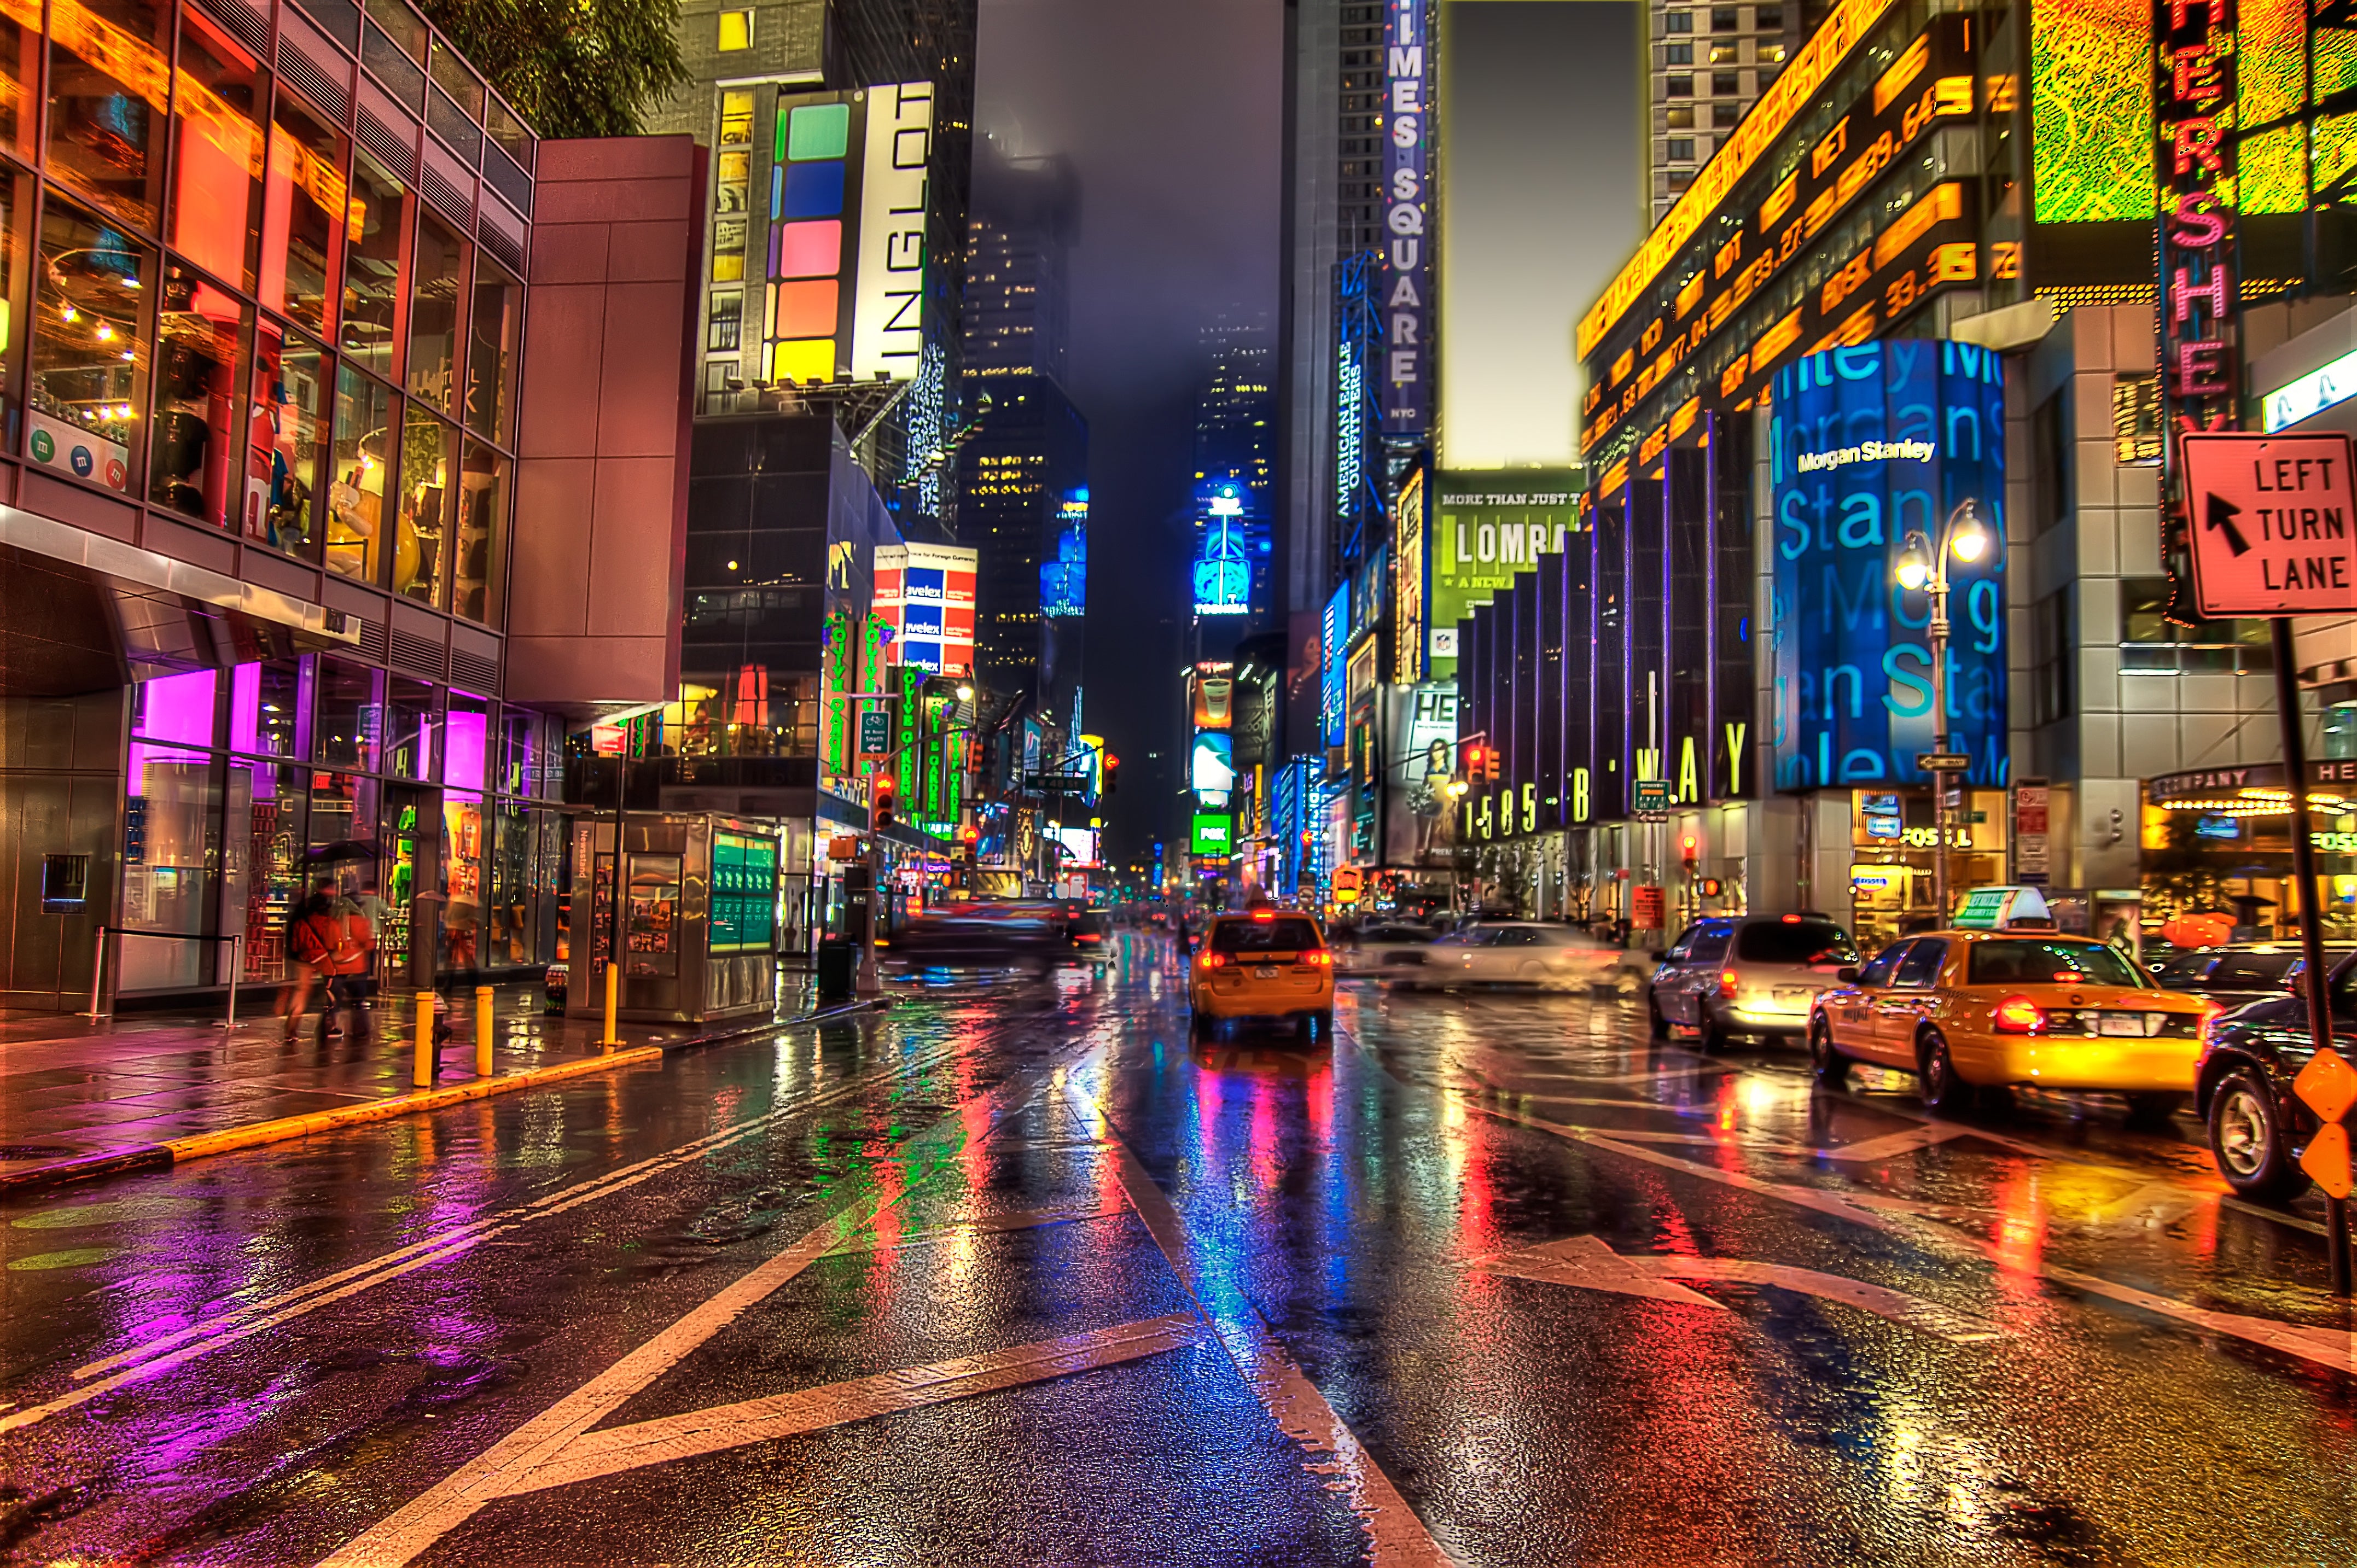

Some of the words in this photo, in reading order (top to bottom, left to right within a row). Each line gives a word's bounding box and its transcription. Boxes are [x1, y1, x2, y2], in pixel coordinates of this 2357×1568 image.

[1389, 0, 1422, 148] IMES
[880, 83, 932, 359] INGLOT
[2172, 0, 2226, 432] ERSHE
[1388, 167, 1423, 383] SQUARE
[1339, 341, 1351, 403] EAGLE
[1349, 364, 1361, 489] OUTFITTERS
[1390, 409, 1416, 419] NYC
[1337, 408, 1350, 518] AMERICAN
[1798, 445, 1860, 474] Morgan
[1861, 438, 1936, 465] Stanley
[2254, 458, 2334, 492] LEFT
[1442, 493, 1483, 505] MORE
[1486, 493, 1527, 505] THAN
[1528, 493, 1567, 505] JUST
[2256, 508, 2344, 541] TURN
[2261, 556, 2349, 590] LANE
[864, 628, 880, 693] OLIVE
[903, 671, 916, 728] OLIVE
[930, 705, 941, 752] OLIE
[1049, 779, 1064, 787] 48
[1067, 779, 1079, 787] St
[1465, 783, 1536, 840] 1585
[579, 830, 588, 878] Newsstand
